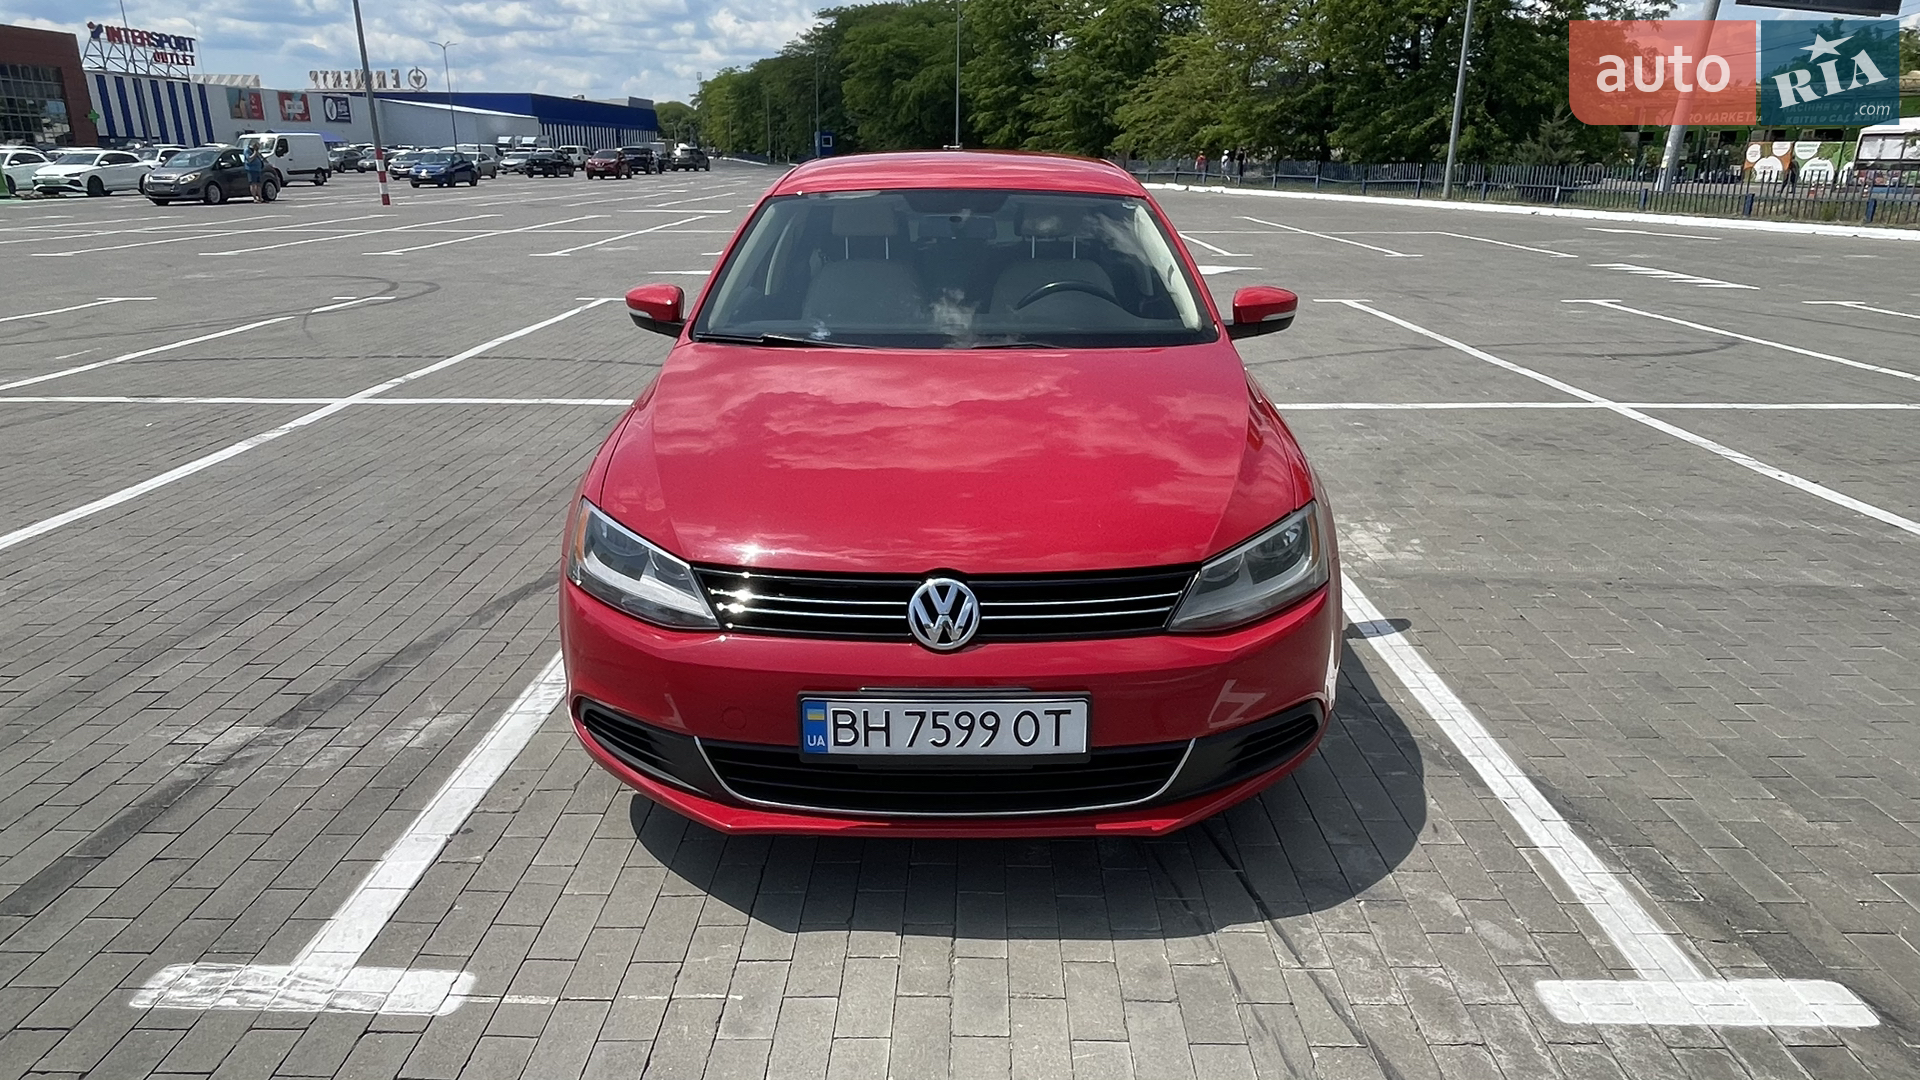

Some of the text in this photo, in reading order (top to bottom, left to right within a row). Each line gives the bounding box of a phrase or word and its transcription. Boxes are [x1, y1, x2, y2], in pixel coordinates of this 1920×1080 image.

[105, 25, 196, 52] INTERSPORT
[152, 50, 195, 66] OUTLET
[911, 580, 976, 647] VW
[807, 735, 826, 747] UA
[831, 709, 1072, 748] BH 7599 OT
